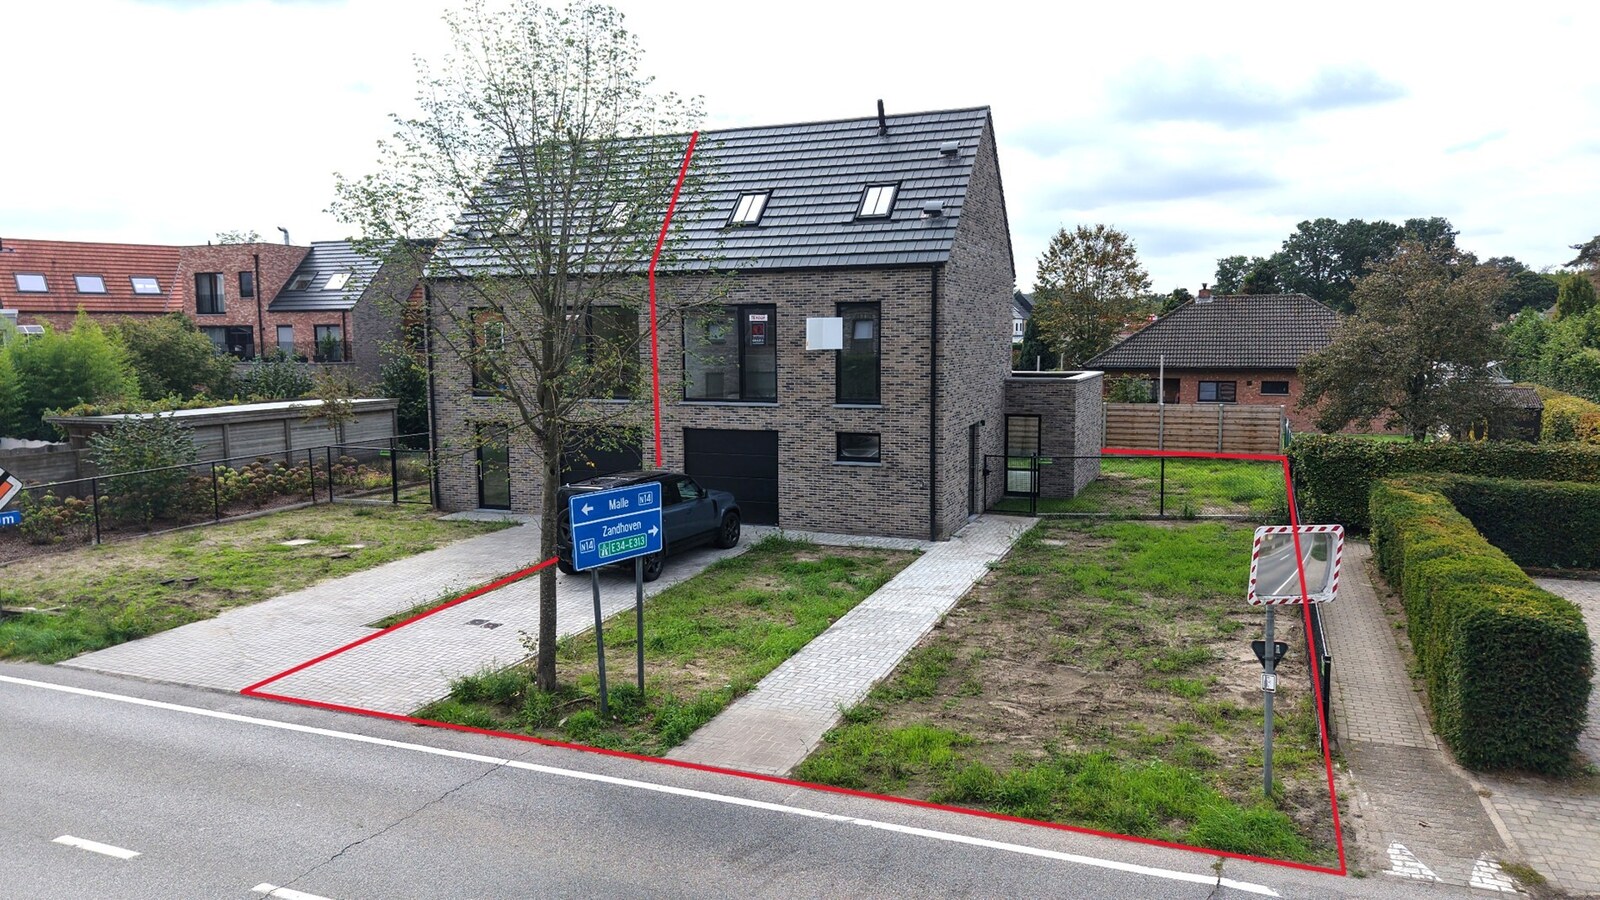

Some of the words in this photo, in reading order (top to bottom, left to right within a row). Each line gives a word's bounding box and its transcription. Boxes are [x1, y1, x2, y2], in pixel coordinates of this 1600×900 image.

[608, 497, 629, 511] Malle
[639, 493, 651, 503] N14
[602, 521, 642, 537] Zandhoven
[581, 540, 594, 551] N14
[611, 536, 645, 553] E34-E313
